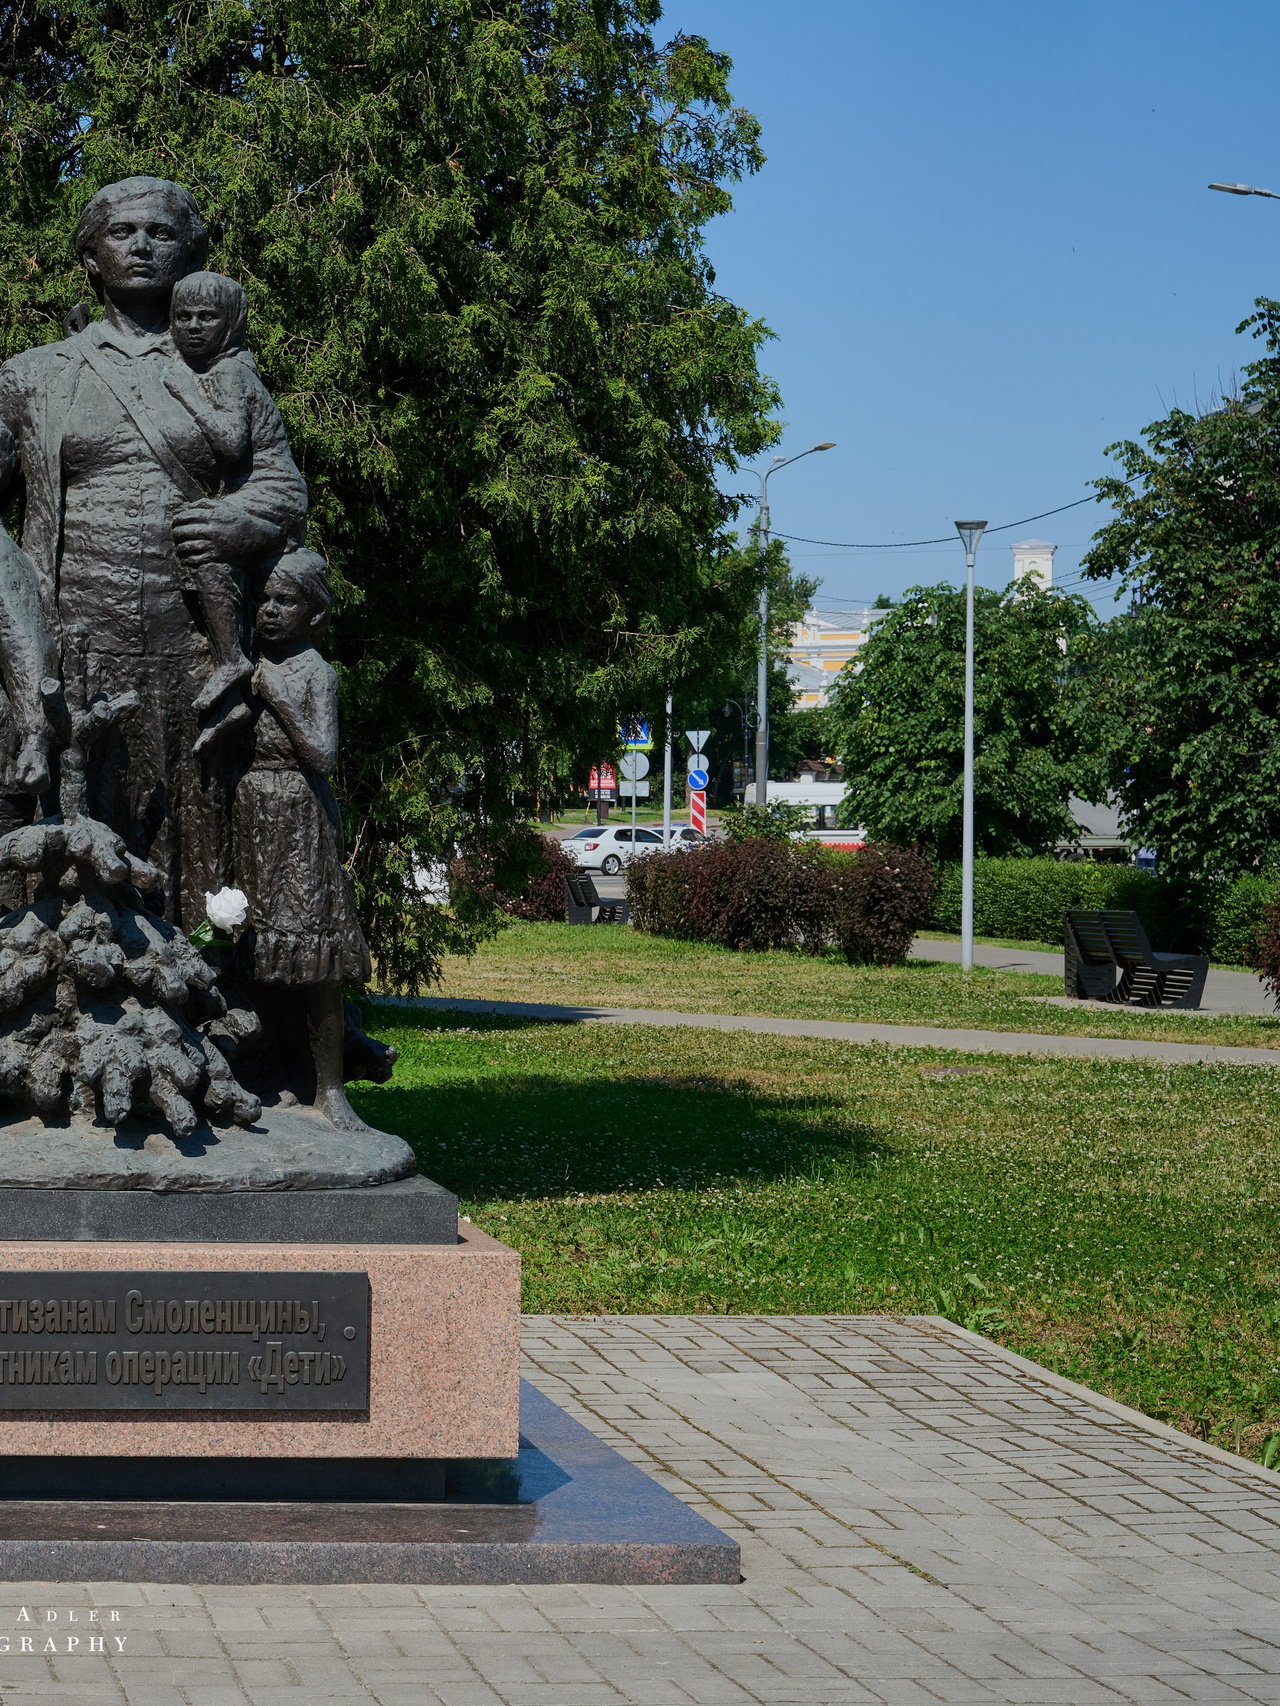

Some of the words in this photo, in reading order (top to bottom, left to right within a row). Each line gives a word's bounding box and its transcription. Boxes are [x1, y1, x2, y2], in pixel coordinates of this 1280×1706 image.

[124, 1290, 327, 1341] Смоленщины,
[105, 1351, 241, 1395] операции
[247, 1341, 348, 1394] «Дети»
